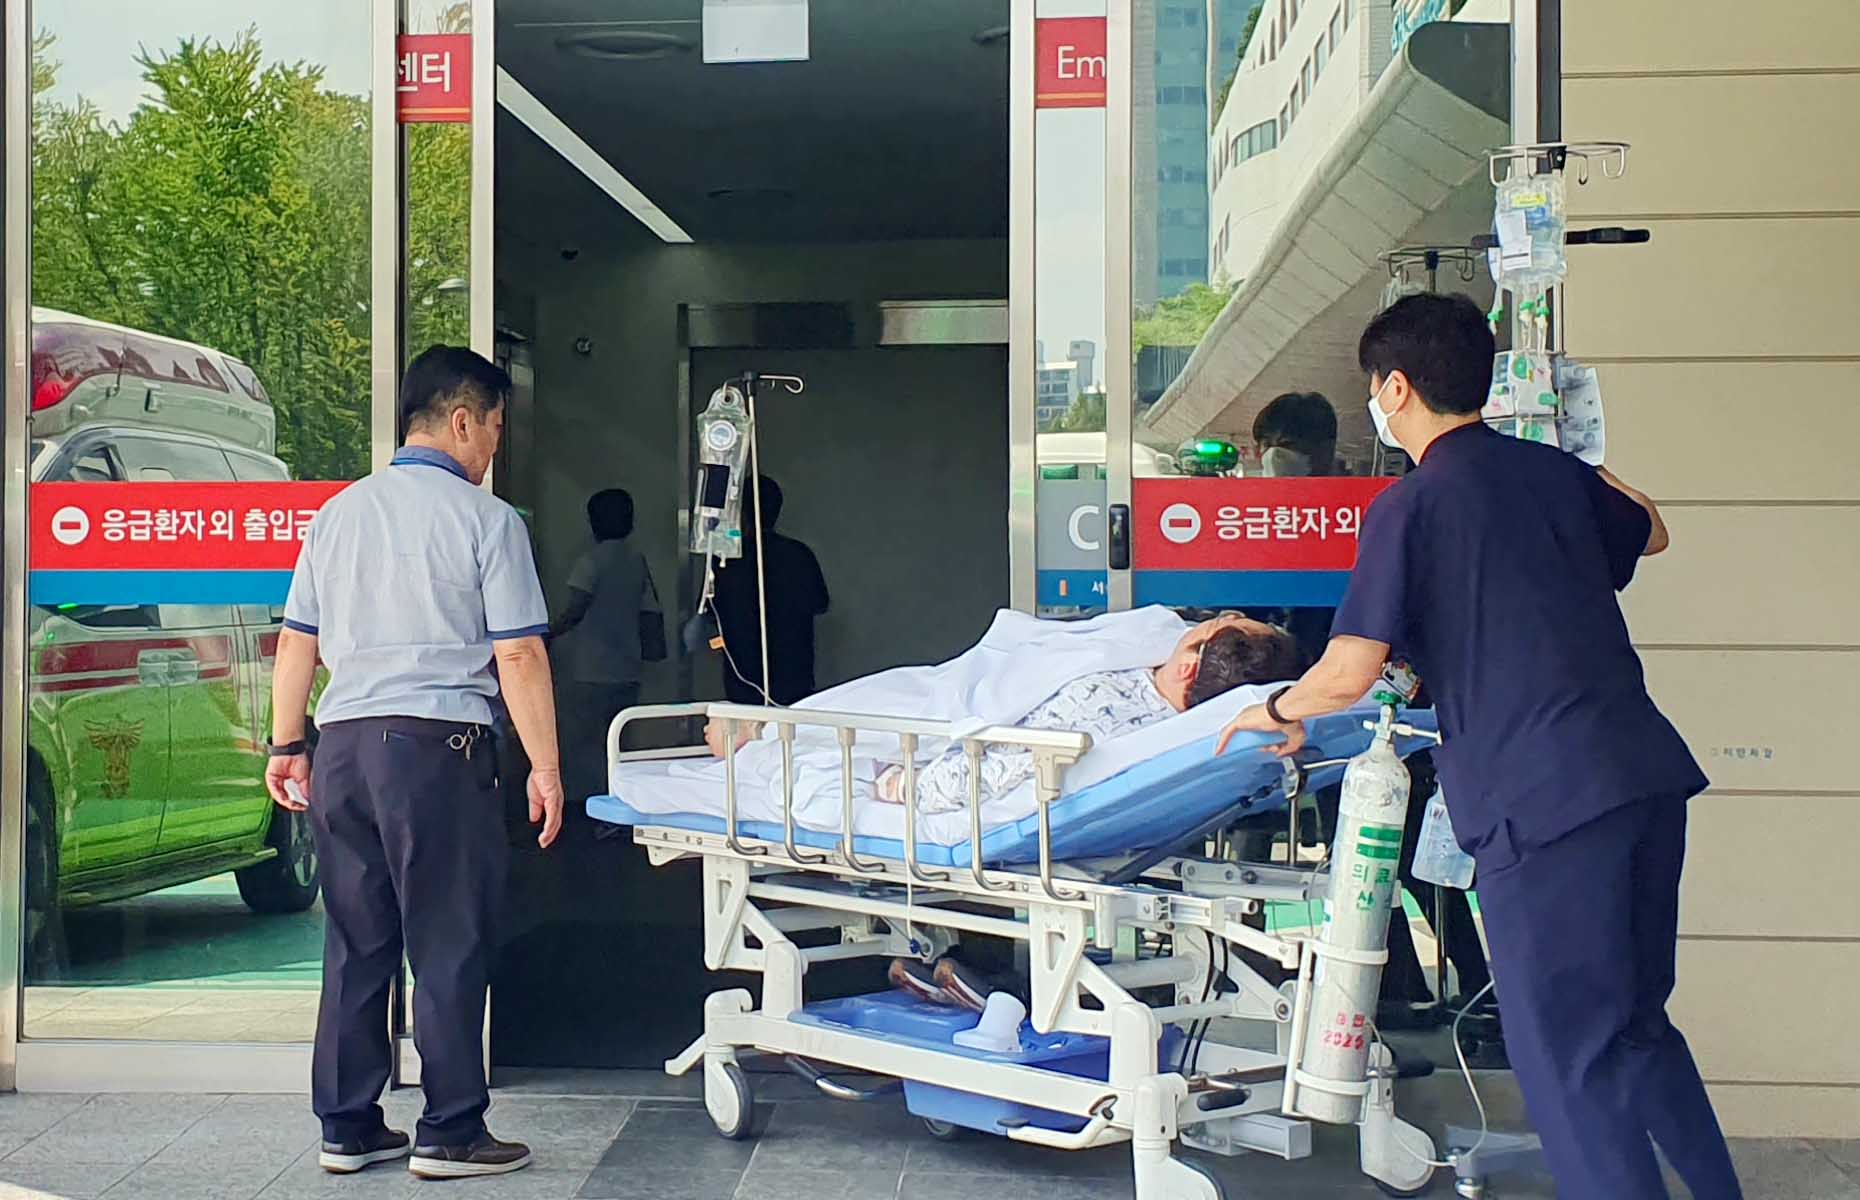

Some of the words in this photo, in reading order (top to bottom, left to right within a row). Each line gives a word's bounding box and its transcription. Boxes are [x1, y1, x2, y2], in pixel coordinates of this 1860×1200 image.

[1057, 45, 1105, 79] Em
[101, 509, 206, 541] 응급환자
[209, 510, 234, 541] 외
[1215, 506, 1330, 540] 응급환자
[1334, 506, 1360, 540] 외
